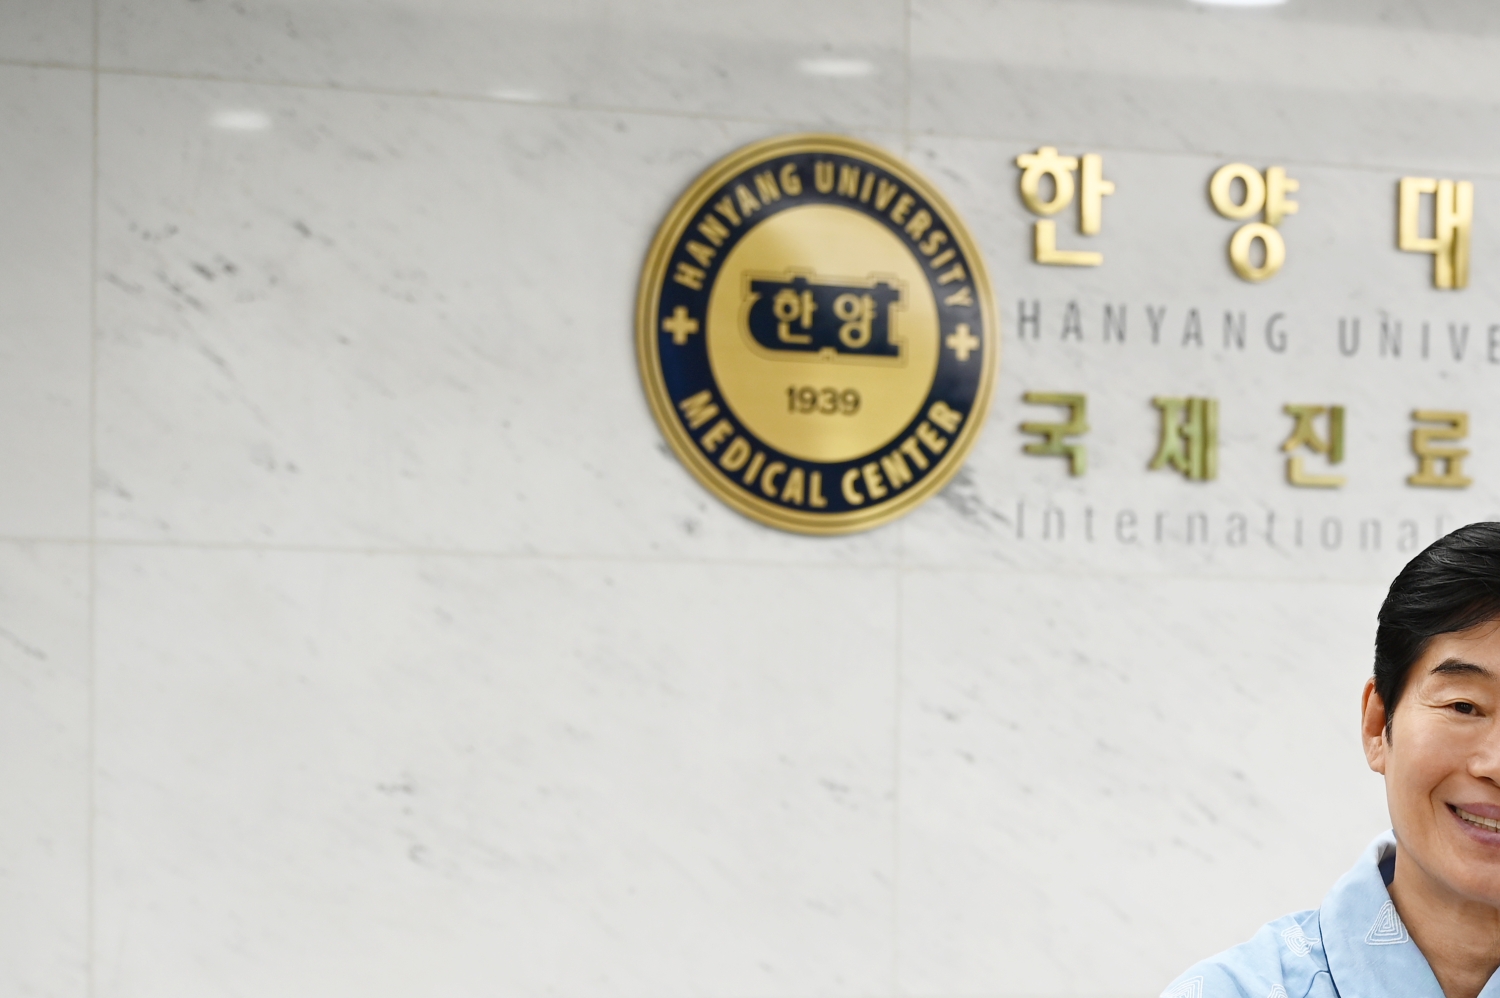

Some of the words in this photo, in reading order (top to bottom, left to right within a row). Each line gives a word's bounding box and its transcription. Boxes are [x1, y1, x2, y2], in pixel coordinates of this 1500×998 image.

[674, 165, 804, 291] HANYANG
[813, 160, 976, 311] UNIVERSITY
[771, 292, 883, 348] 한양
[1016, 298, 1290, 354] HANYANG
[784, 386, 862, 416] 1939
[679, 390, 829, 509] MEDICAL
[841, 399, 964, 506] CENTER
[1014, 499, 1446, 554] International
